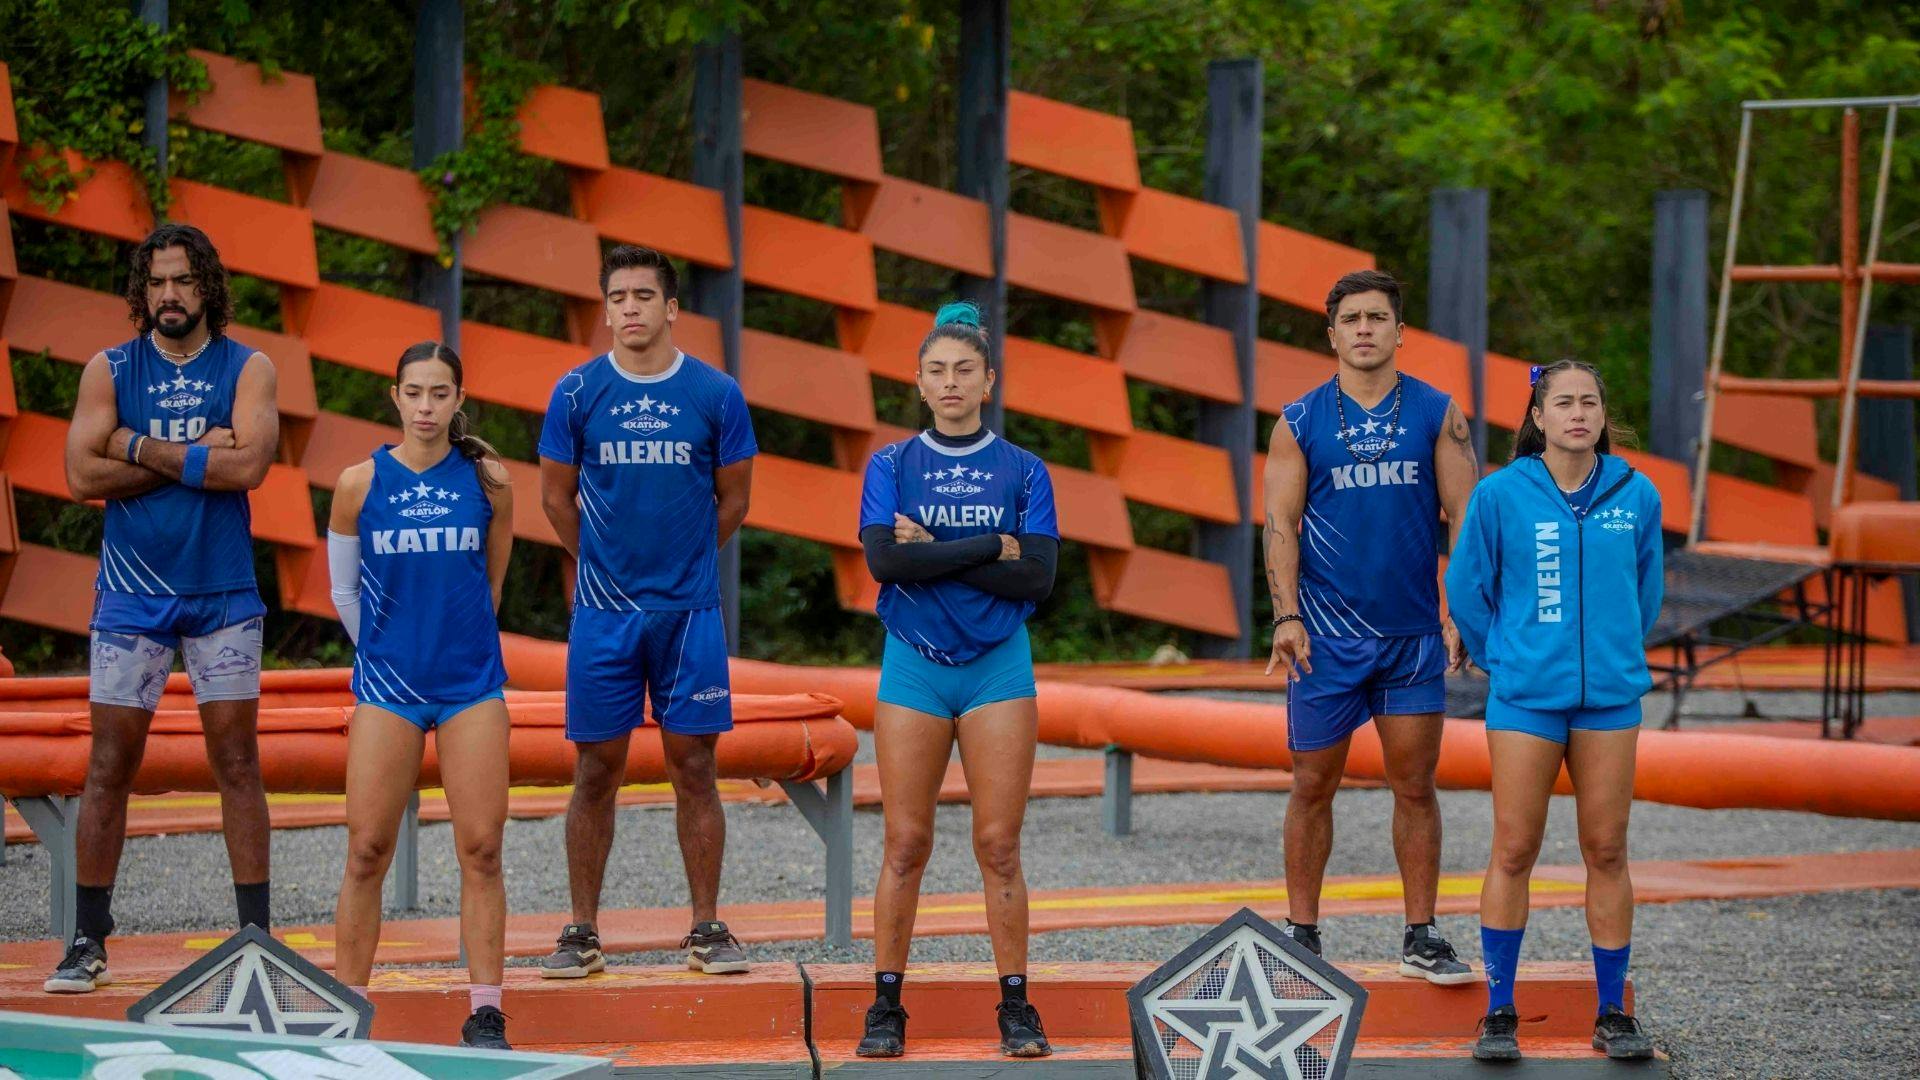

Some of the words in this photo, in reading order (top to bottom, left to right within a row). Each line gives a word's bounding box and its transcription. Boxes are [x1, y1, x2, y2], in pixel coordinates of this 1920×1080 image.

[149, 417, 207, 442] LEO
[599, 441, 692, 465] ALEXIS
[1332, 461, 1419, 490] KOKE
[919, 505, 1005, 527] VALERY
[372, 527, 480, 555] KATIA
[1535, 521, 1562, 623] EVELYN
